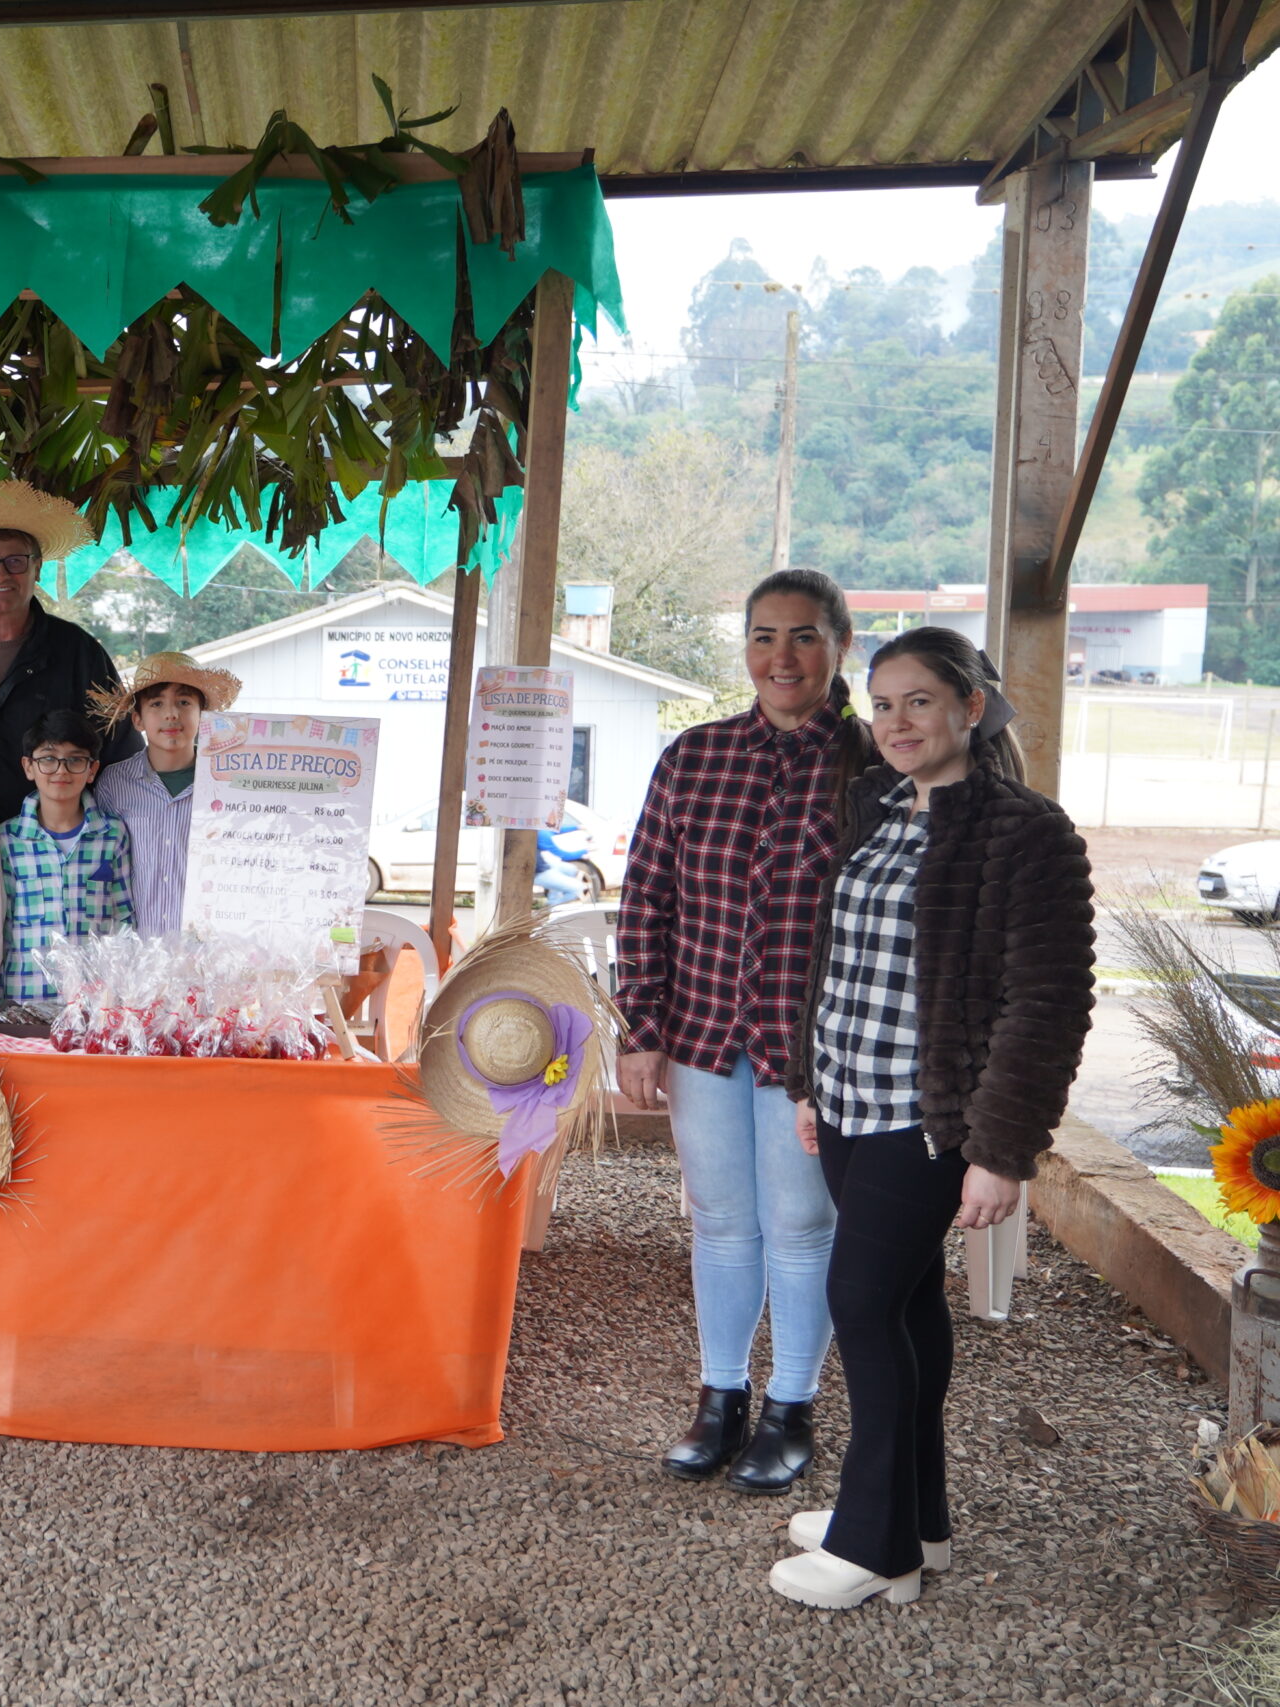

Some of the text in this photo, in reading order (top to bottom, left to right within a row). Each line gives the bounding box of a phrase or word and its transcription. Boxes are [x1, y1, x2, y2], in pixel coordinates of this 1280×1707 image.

[328, 630, 371, 642] MUNICÍPIO
[375, 632, 385, 642] DE
[389, 632, 413, 642] NOVO
[385, 673, 446, 684] TUTELAR
[484, 692, 568, 708] LISTA DE PREÇOS
[491, 723, 505, 731] MAÇÃ
[215, 752, 358, 778] LISTA DE PREÇOS
[252, 780, 296, 790] QUERMESSE
[298, 782, 324, 791] JULINA
[250, 804, 261, 812] DO
[264, 804, 287, 814] AMOR
[314, 806, 325, 816] R$
[215, 910, 247, 920] BISCUIT
